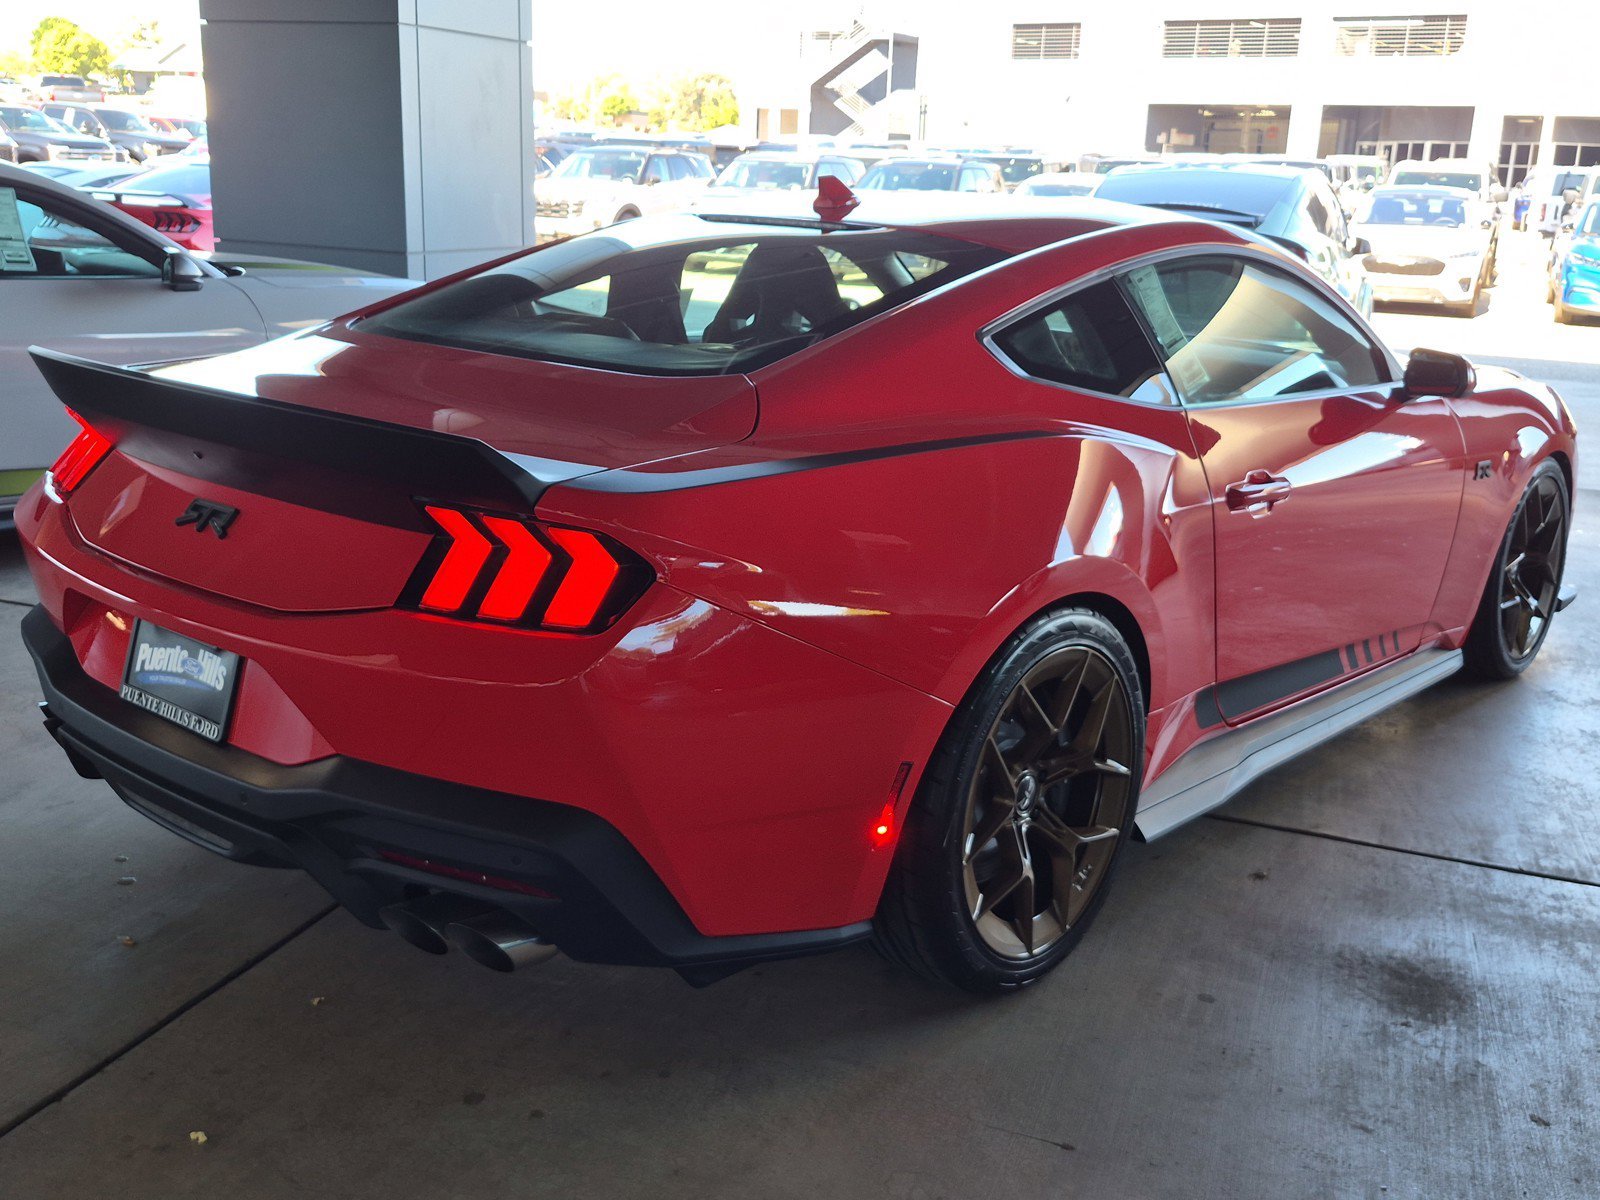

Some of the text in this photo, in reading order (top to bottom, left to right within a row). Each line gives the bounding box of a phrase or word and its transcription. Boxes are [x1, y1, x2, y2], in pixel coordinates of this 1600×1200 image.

[135, 643, 227, 691] Puente Hills
[121, 684, 219, 740] PUENTE HILLS FORD
